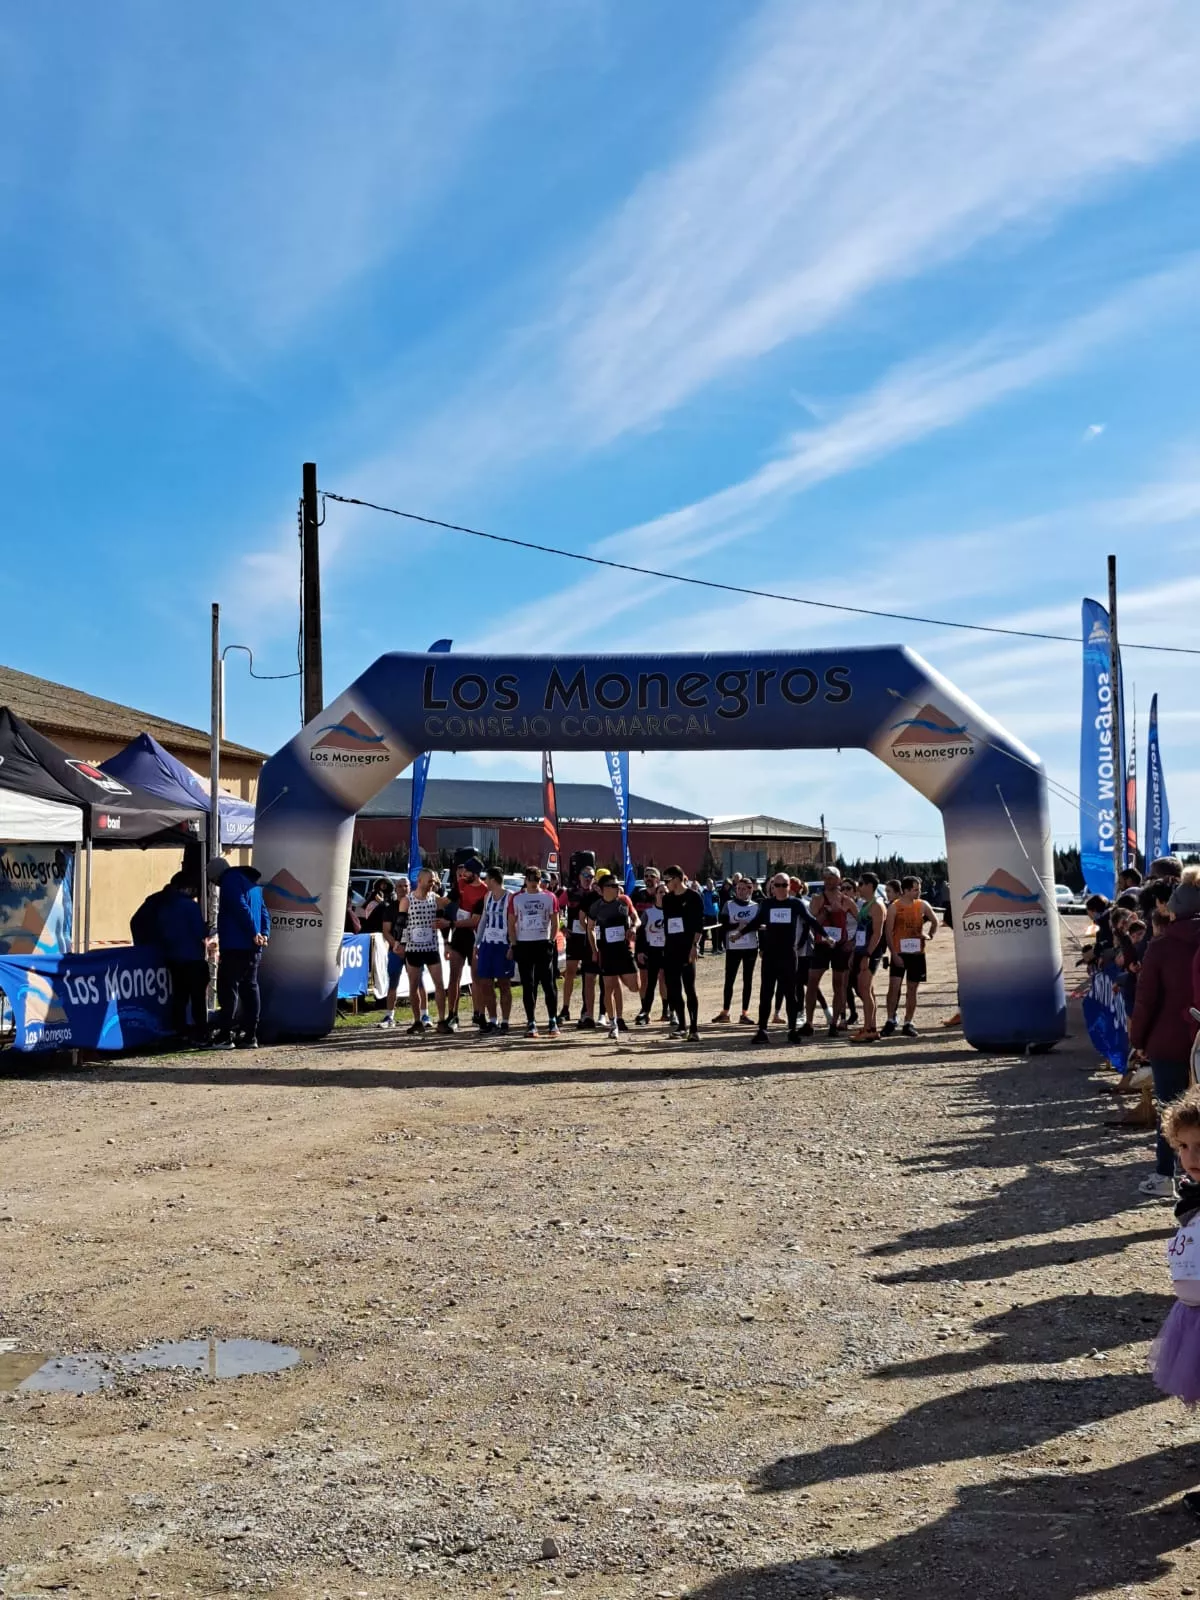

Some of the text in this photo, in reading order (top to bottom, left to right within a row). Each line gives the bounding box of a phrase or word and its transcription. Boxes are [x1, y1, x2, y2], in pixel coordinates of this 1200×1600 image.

[422, 664, 853, 719] Los Monegros
[424, 714, 716, 737] CONSEJO COMARCAL
[310, 752, 390, 765] Los Monegros
[892, 746, 974, 759] Los Monegros
[1151, 743, 1162, 831] Monegros
[272, 916, 323, 928] onegros
[963, 917, 1048, 931] Los Monegros
[63, 969, 99, 1005] Los
[25, 1028, 38, 1045] Los
